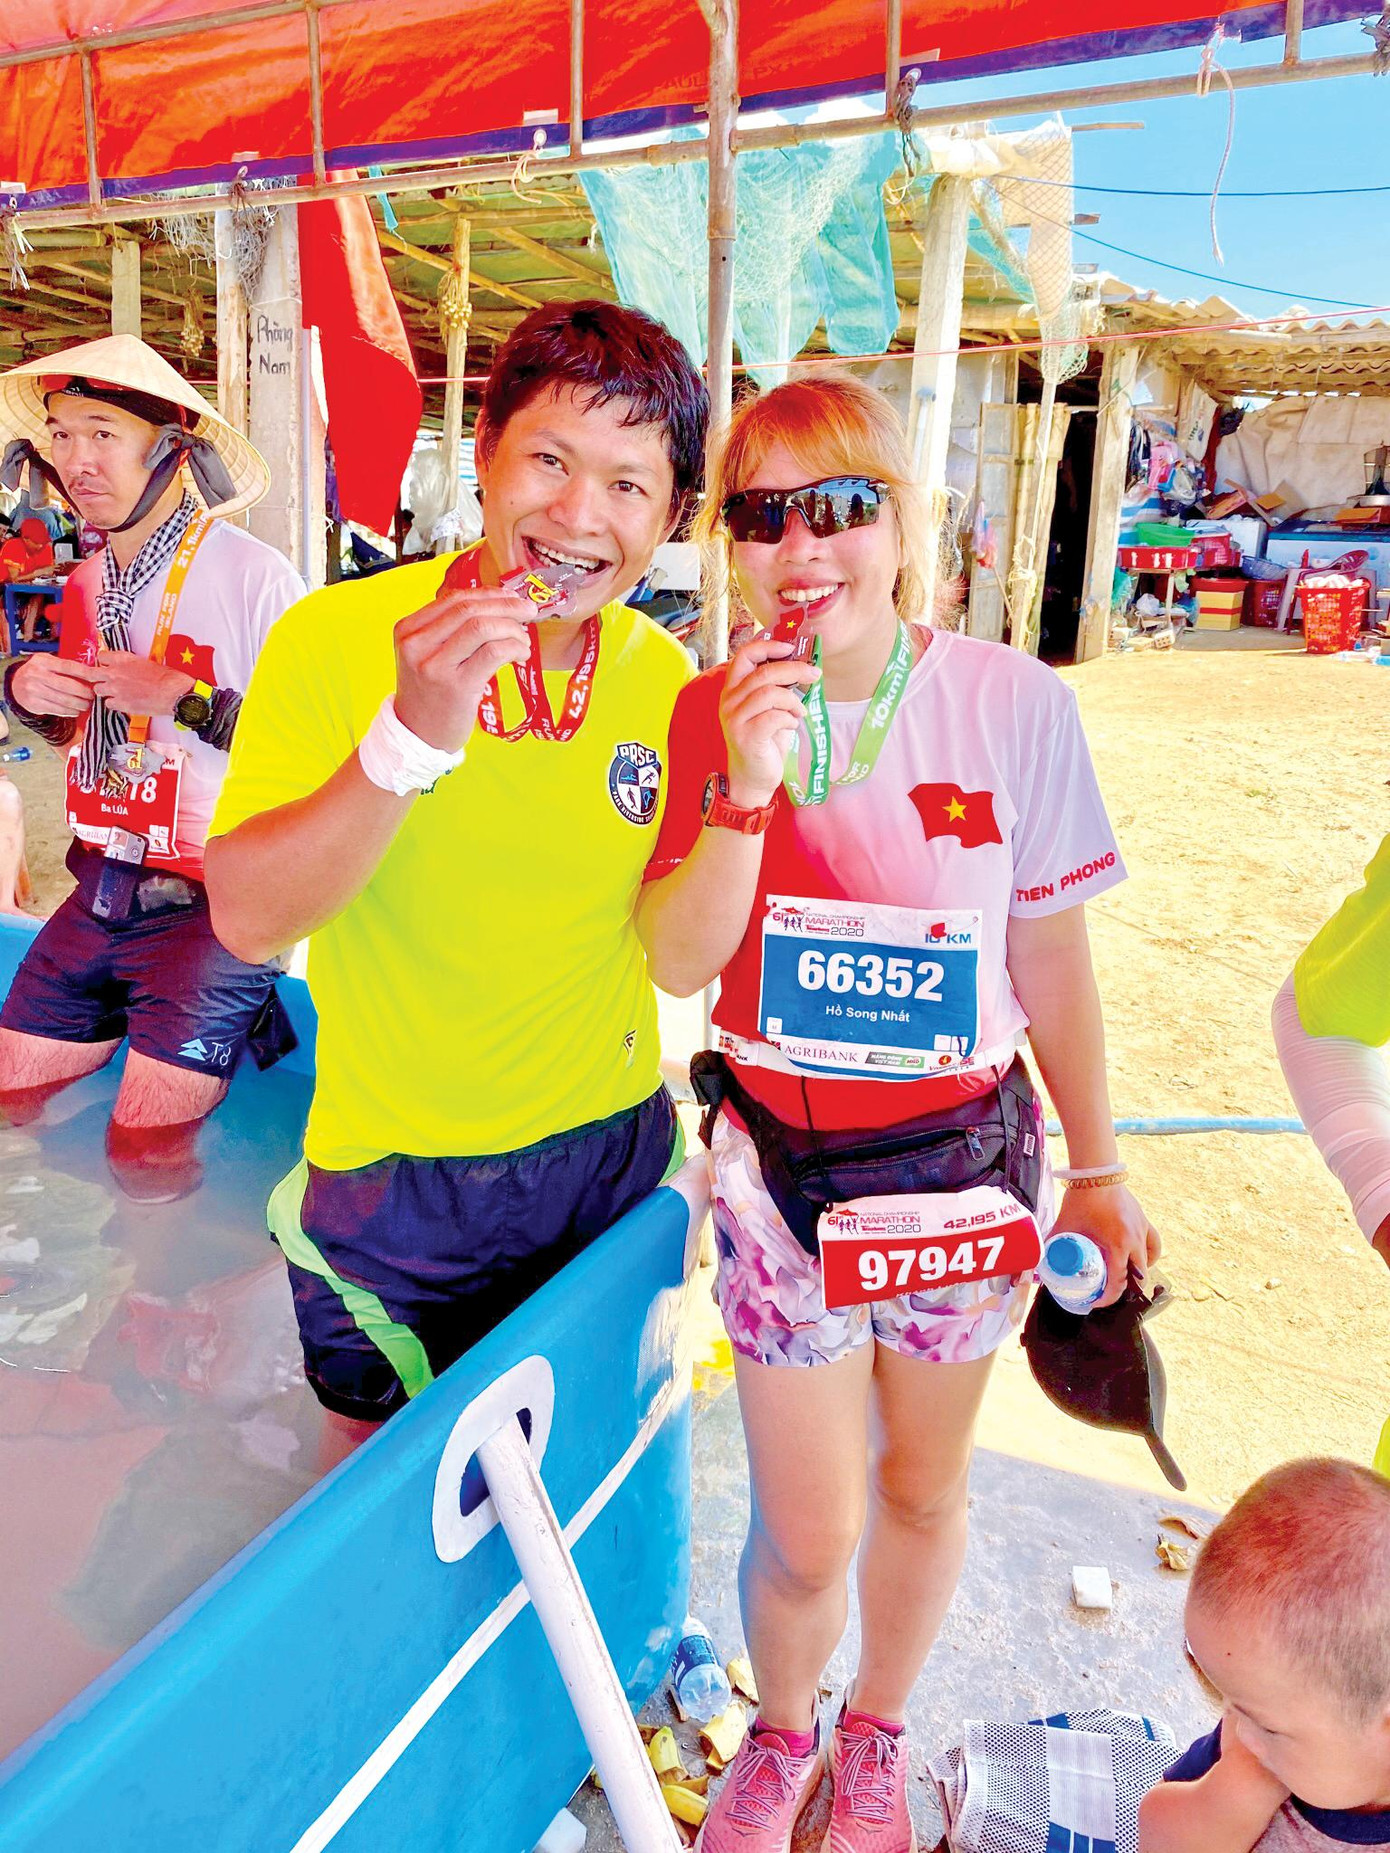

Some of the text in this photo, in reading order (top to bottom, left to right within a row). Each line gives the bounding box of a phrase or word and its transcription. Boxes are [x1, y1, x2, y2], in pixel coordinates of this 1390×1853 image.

[259, 353, 290, 375] Nam
[568, 620, 597, 719] 42,195km
[871, 668, 905, 730] 10km
[808, 683, 827, 794] FINISHER
[101, 803, 112, 814] Ba
[1016, 851, 1116, 902] TIEN PHONG
[805, 916, 866, 928] MARATHON
[830, 926, 865, 937] 2020
[947, 933, 972, 944] KM
[797, 949, 945, 1002] 66352
[825, 1003, 911, 1023] Hồ Song Nhất
[784, 1044, 859, 1063] AGRIBANK
[860, 1216, 921, 1225] MARATHON
[943, 1202, 1021, 1230] 42,195 KM
[887, 1223, 921, 1234] 2020
[857, 1235, 1006, 1291] 97947
